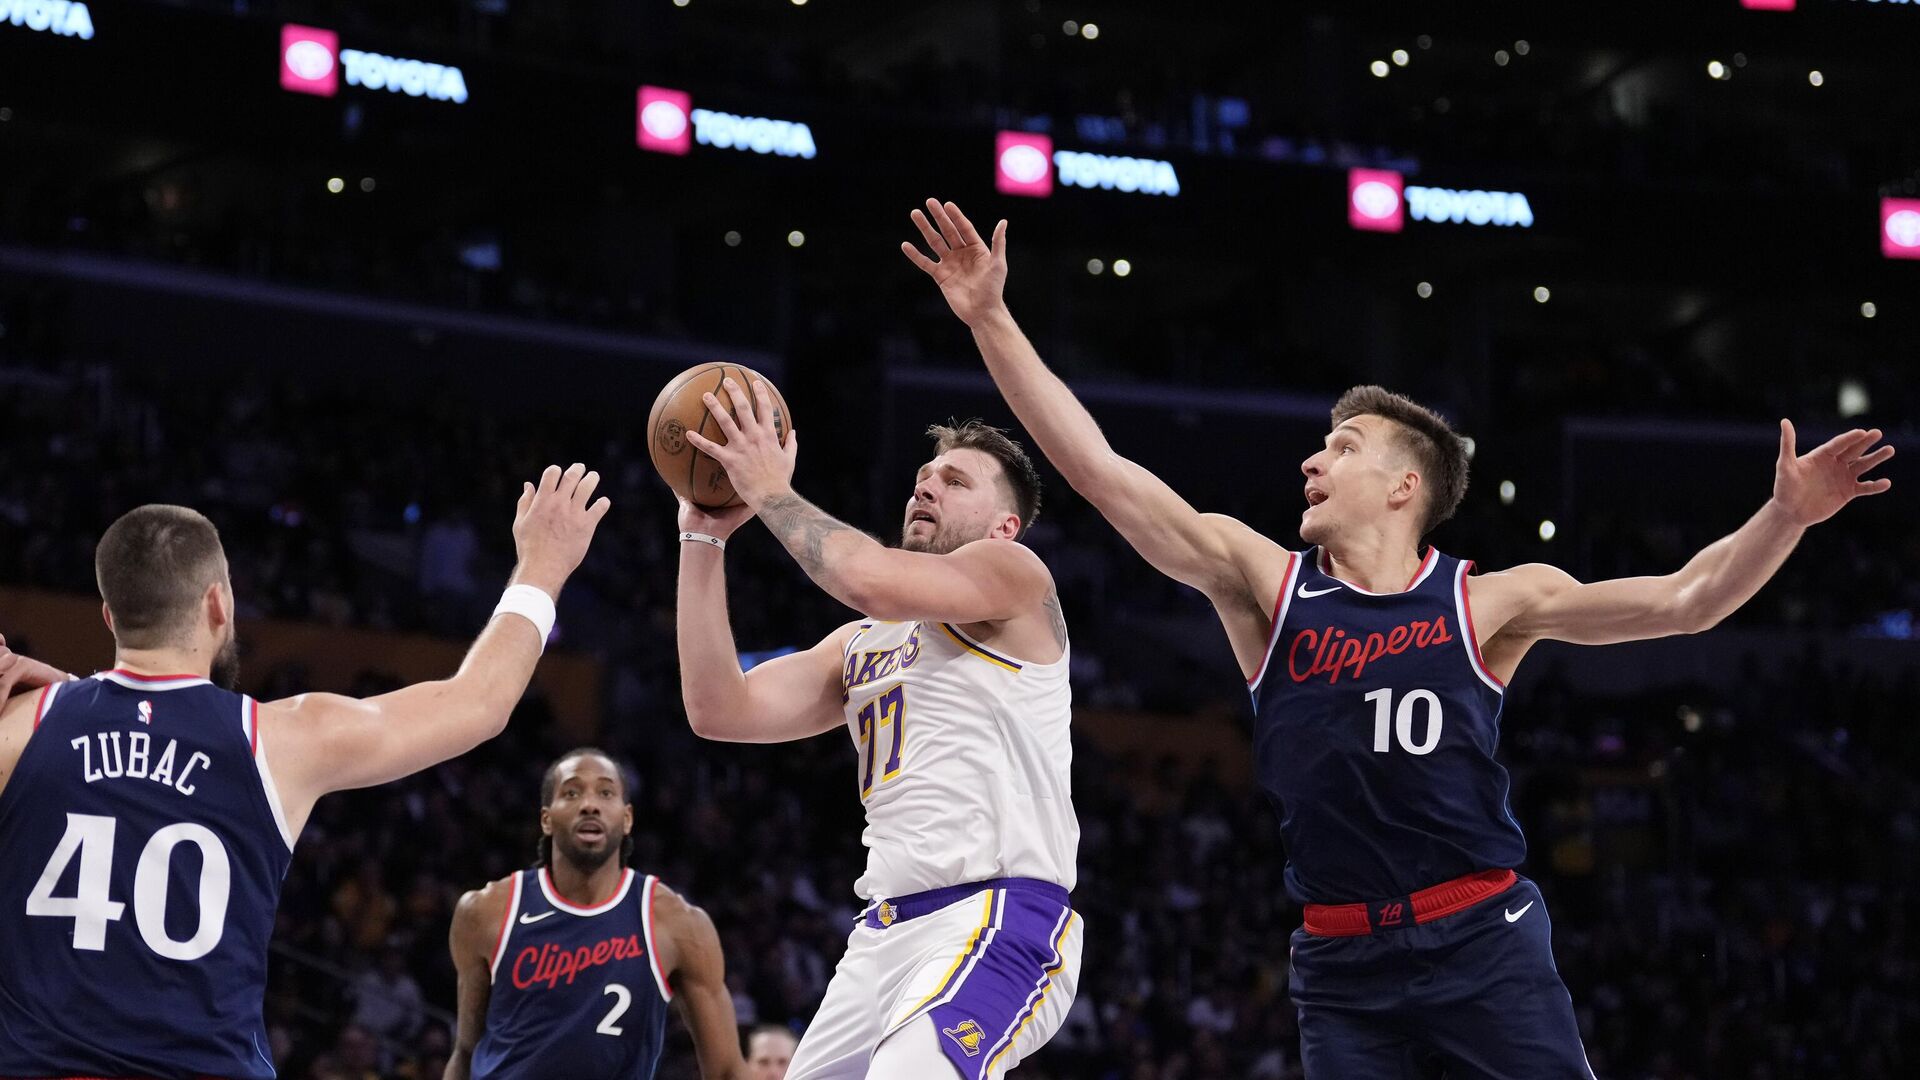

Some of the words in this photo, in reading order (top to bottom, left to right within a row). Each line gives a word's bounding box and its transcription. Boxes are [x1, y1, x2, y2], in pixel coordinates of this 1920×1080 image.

[340, 49, 468, 103] TOYOTA
[691, 108, 817, 158] TOYOTA
[1288, 615, 1453, 684] Clippers
[857, 681, 906, 801] 77
[1364, 687, 1443, 756] 10
[71, 731, 211, 796] ZUBAC
[26, 812, 231, 961] 40
[512, 934, 643, 990] Clippers
[596, 983, 632, 1036] 2
